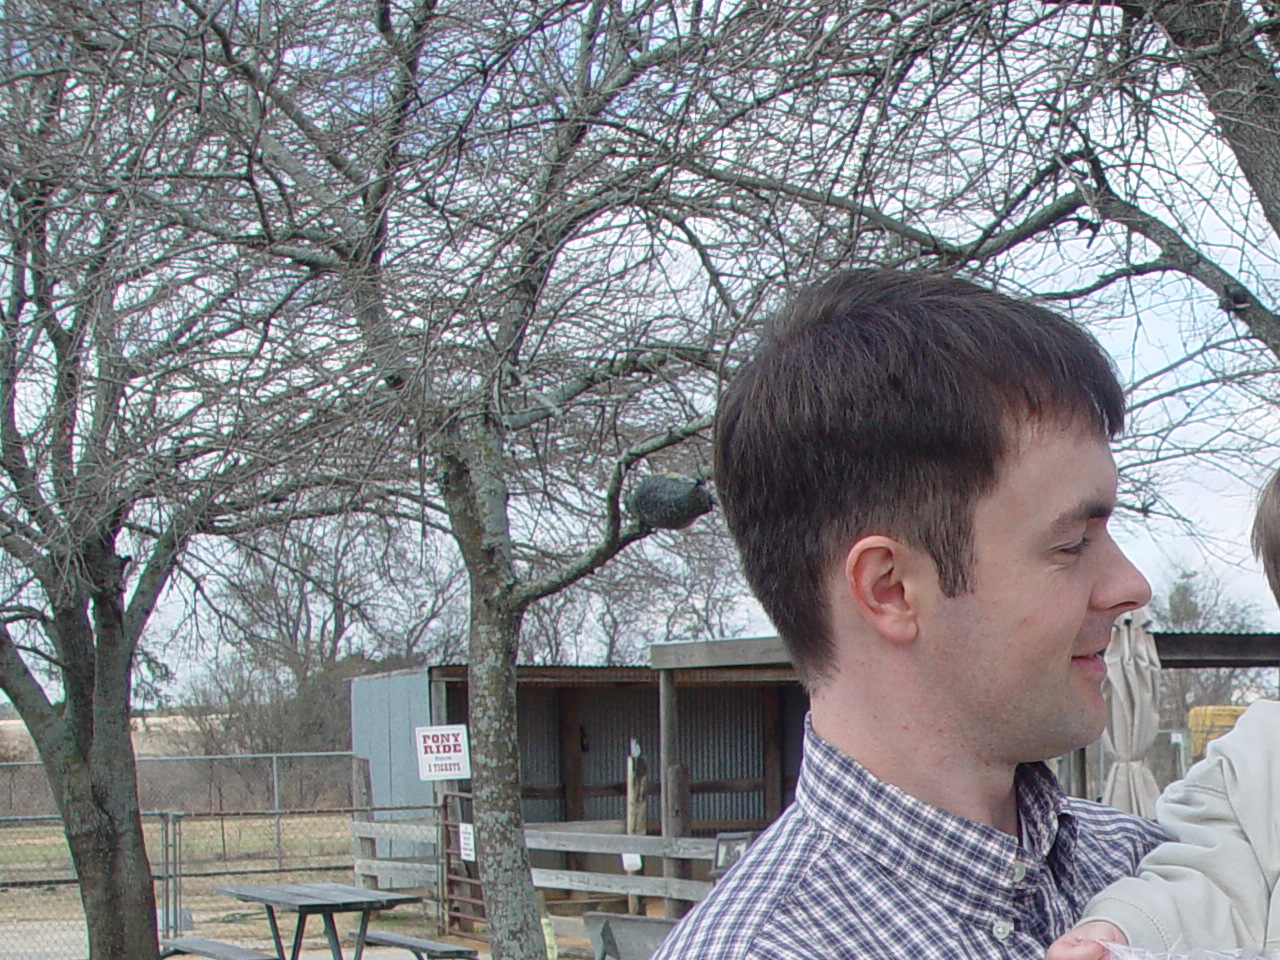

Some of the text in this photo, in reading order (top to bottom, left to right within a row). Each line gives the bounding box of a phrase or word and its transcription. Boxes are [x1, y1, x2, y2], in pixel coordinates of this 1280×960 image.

[422, 733, 461, 745] PONY
[423, 744, 462, 755] RIDE
[433, 762, 461, 772] TICKETS
